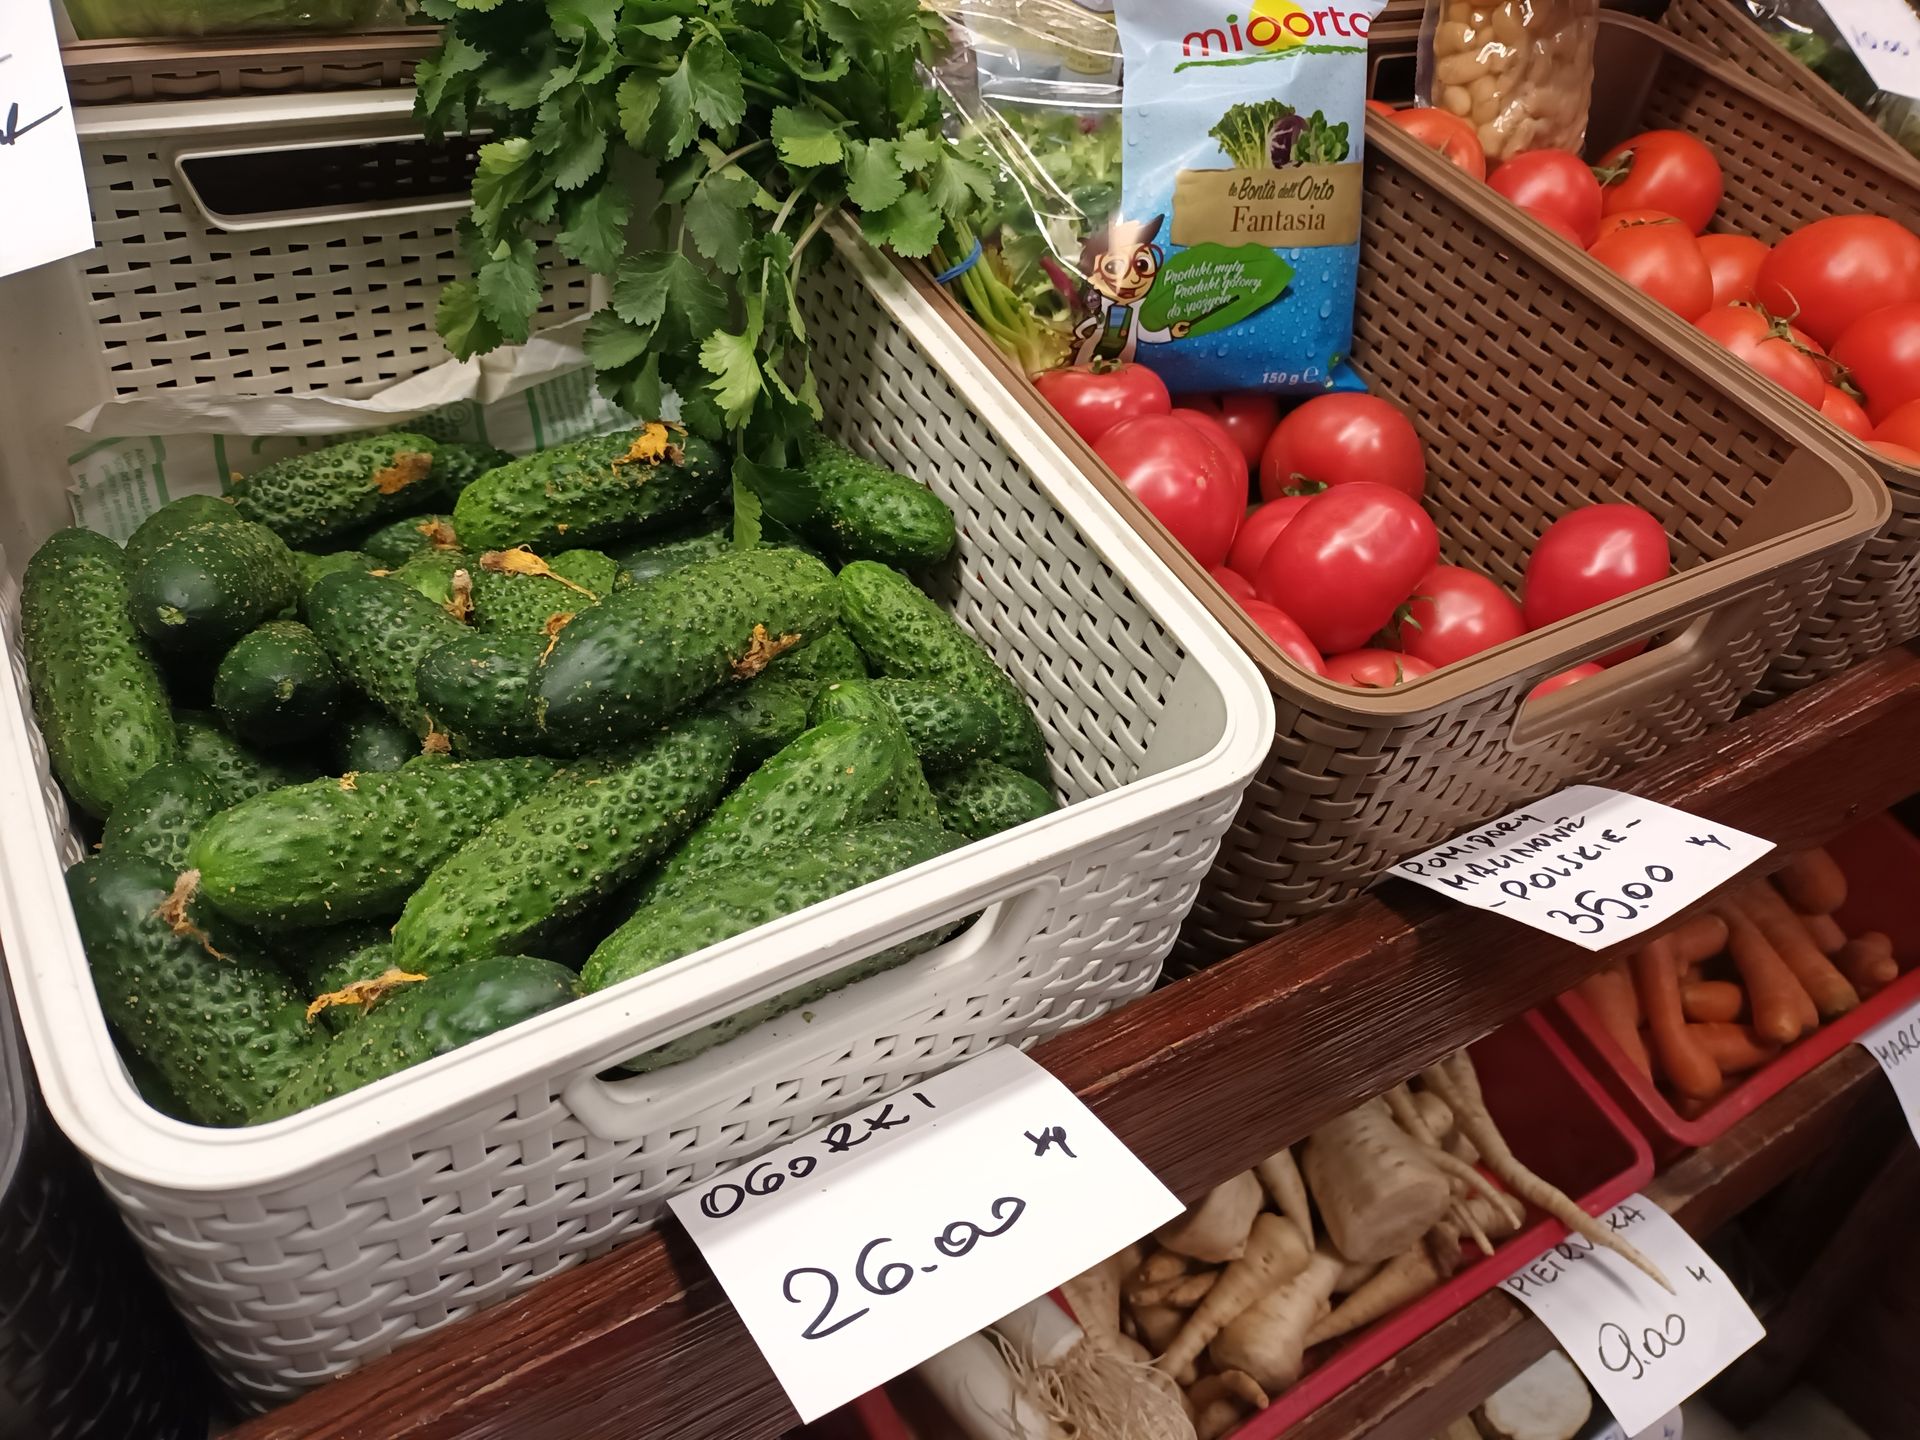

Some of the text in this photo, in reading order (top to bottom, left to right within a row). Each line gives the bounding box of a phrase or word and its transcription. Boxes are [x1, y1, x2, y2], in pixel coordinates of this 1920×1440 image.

[1238, 175, 1275, 201] Bontà
[1230, 204, 1327, 232] Fantasia
[1163, 261, 1213, 287] Produkt
[1173, 277, 1221, 301] Produkt
[1166, 303, 1181, 320] do
[1262, 372, 1287, 384] 150
[1288, 374, 1299, 386] g
[782, 1195, 1027, 1341] 26.00
[1597, 1313, 1687, 1380] 9.00
